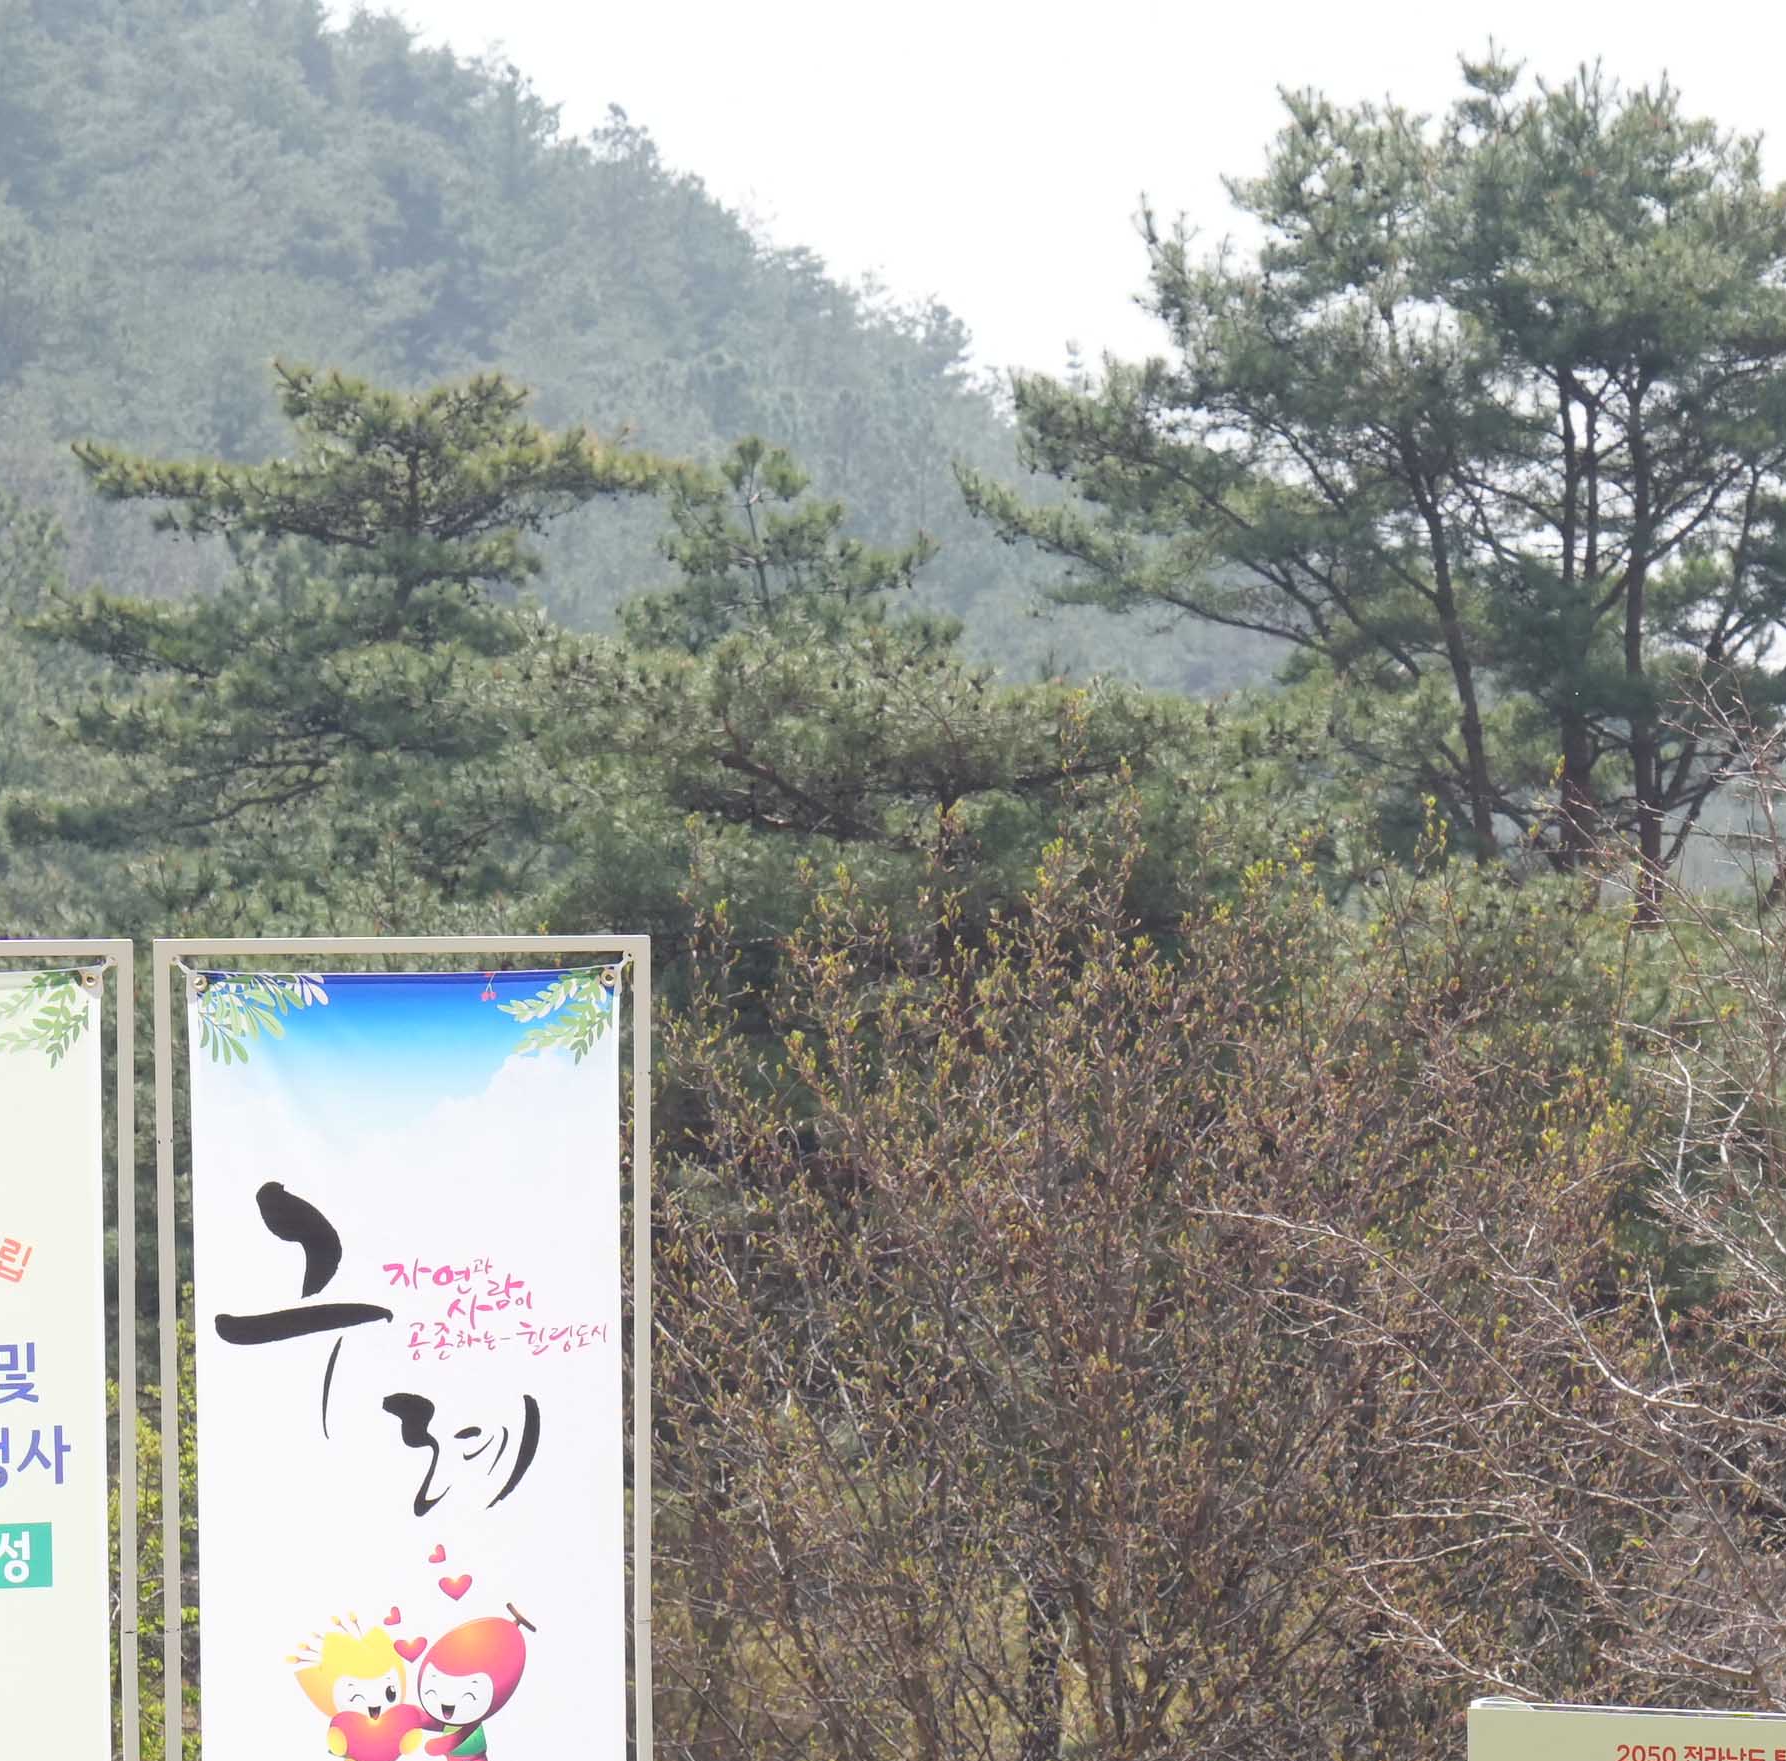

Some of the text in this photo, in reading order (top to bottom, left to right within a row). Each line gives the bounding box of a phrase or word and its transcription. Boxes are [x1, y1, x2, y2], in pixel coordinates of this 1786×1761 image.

[382, 1257, 494, 1295] 자연과
[215, 1181, 542, 1518] 구례
[516, 1321, 608, 1356] 힐링도시
